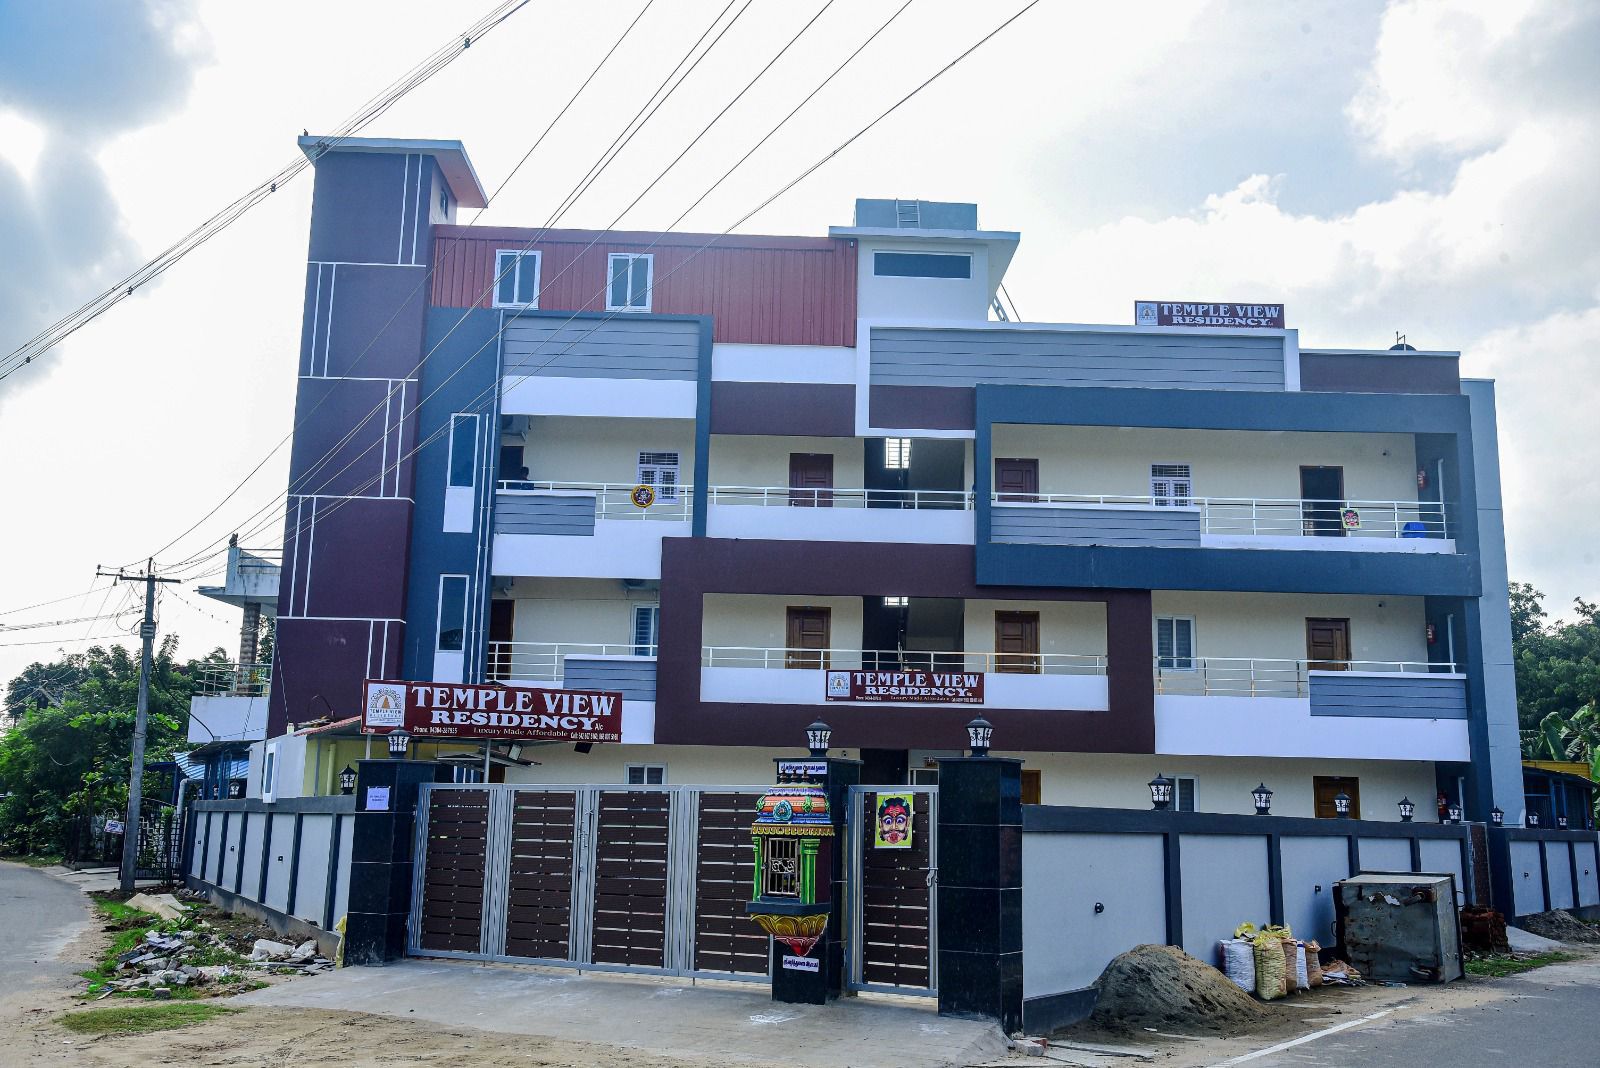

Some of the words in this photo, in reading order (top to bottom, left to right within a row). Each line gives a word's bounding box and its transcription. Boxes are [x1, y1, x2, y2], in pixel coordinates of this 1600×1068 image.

[1161, 303, 1230, 317] TEMPLE
[1235, 305, 1280, 318] VIEW
[1172, 316, 1269, 326] RESIDENCY
[853, 672, 927, 687] TEMPLE
[932, 674, 979, 688] VIEW
[865, 686, 968, 696] RESIDENCY
[412, 686, 533, 712] TEMPLE
[542, 692, 615, 716] VIEW
[430, 710, 598, 731] RESIDENCY
[473, 727, 501, 736] Luxury
[503, 728, 525, 736] Made
[526, 729, 568, 737] Affordable
